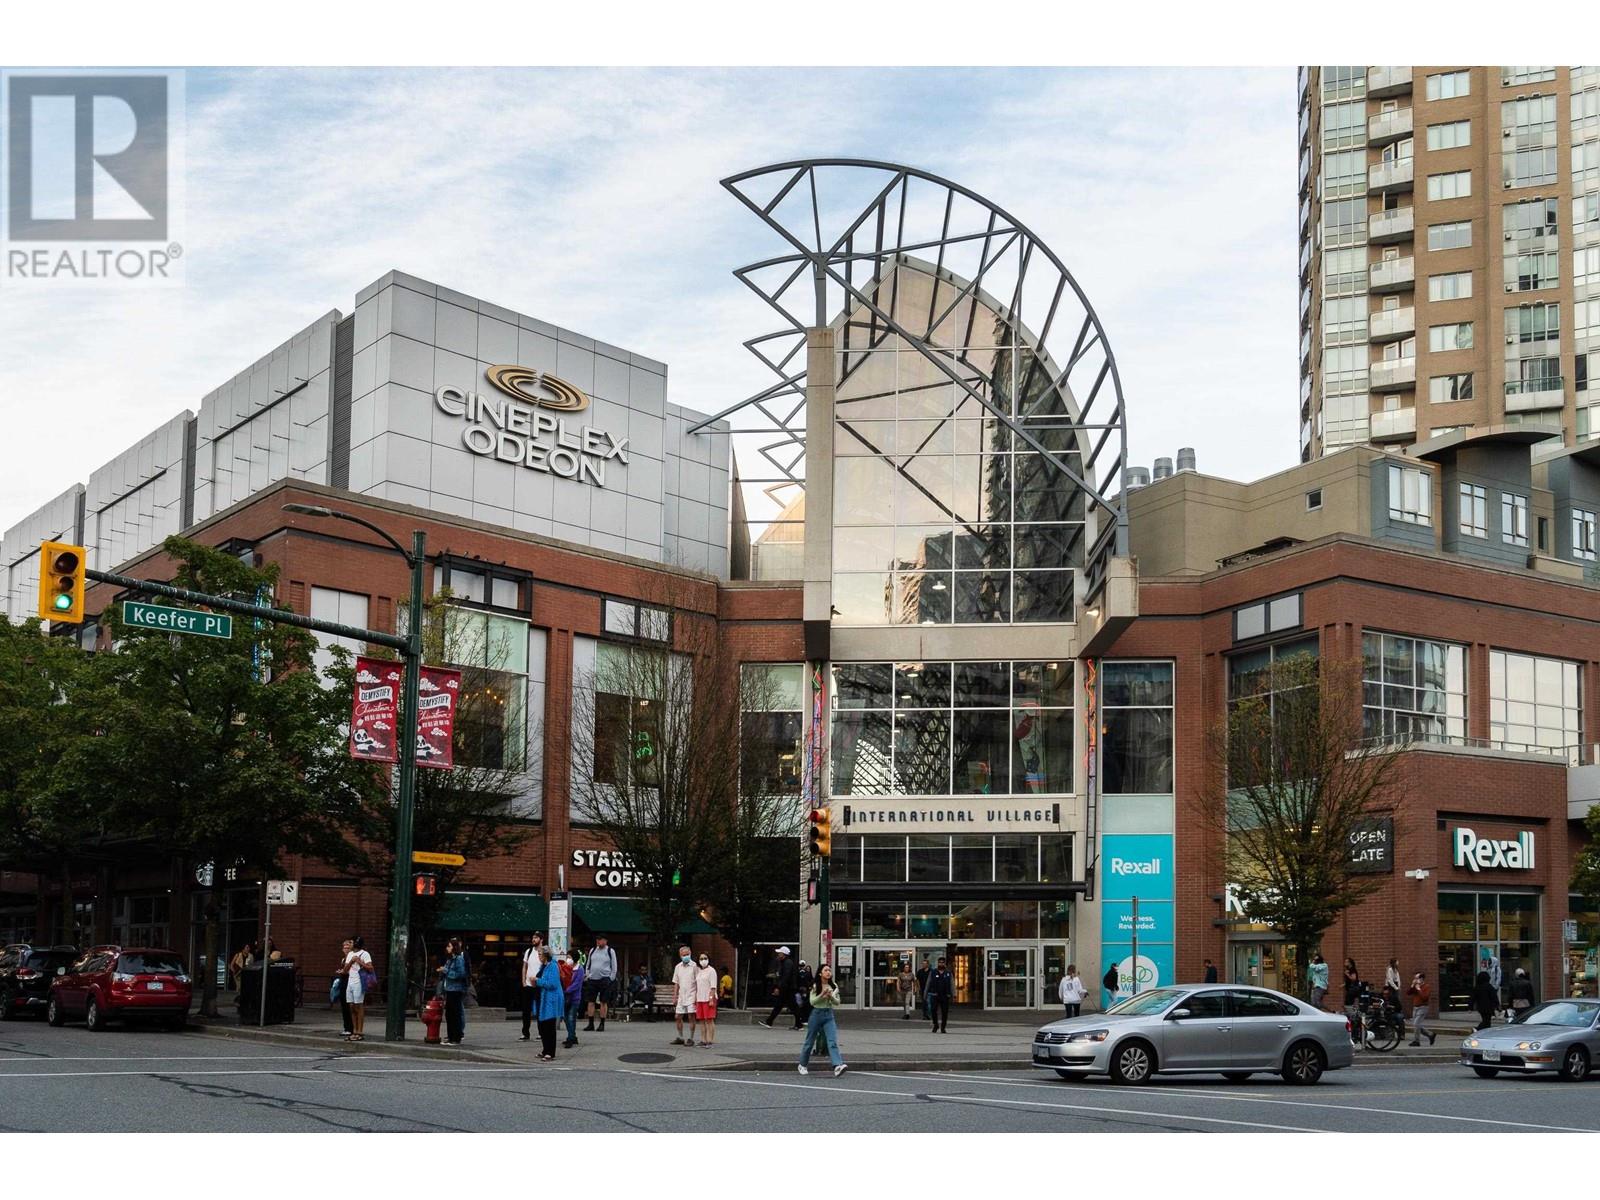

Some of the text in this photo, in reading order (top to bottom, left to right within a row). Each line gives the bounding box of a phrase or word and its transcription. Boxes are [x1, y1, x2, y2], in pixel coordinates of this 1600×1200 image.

[435, 384, 630, 465] CINEPLEX
[462, 425, 606, 487] ODEON
[133, 606, 222, 634] Keefer Pl
[361, 688, 391, 700] DEMYSTIFY
[419, 695, 449, 708] DEMYSTIFY
[852, 809, 1052, 823] INTERNATIONAL VILLAGE
[1349, 829, 1386, 844] OPEN
[1352, 848, 1385, 862] LATE
[1453, 827, 1535, 872] Rexall
[1111, 857, 1161, 876] Rexall
[1120, 974, 1133, 983] Be
